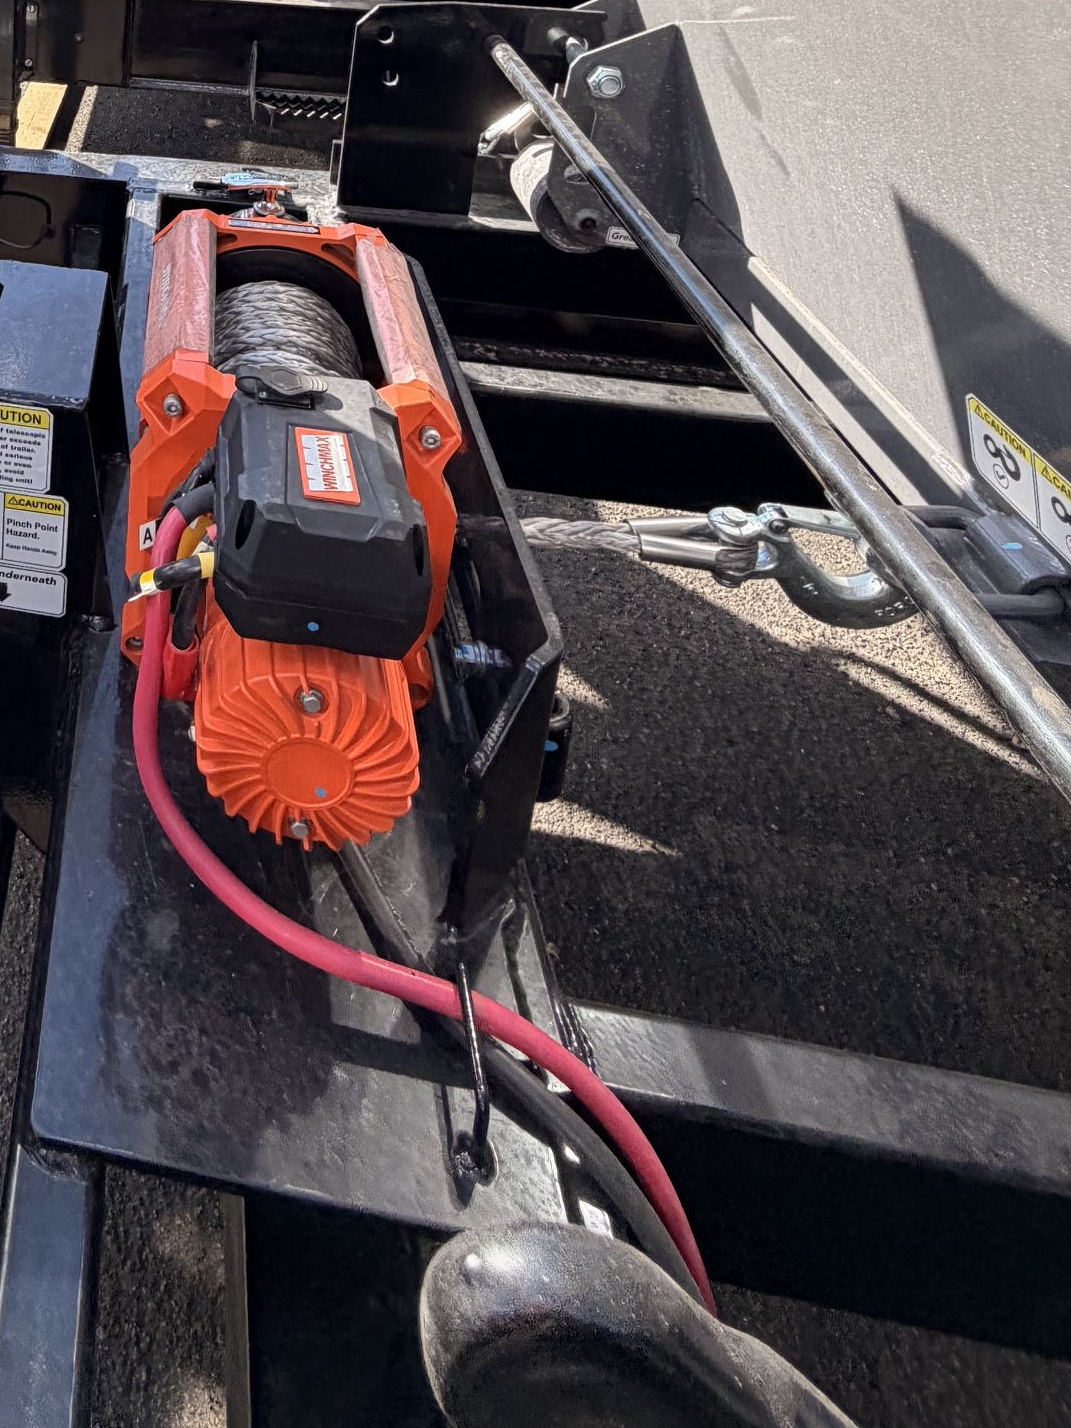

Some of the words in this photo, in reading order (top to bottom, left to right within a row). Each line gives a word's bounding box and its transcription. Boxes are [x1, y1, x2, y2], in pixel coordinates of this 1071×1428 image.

[611, 232, 633, 242] Gre
[5, 428, 46, 439] telescopic
[984, 412, 1027, 458] CAUTION
[9, 437, 41, 447] exceeds
[4, 452, 33, 461] serious
[13, 461, 32, 469] even
[315, 436, 338, 490] WINCHMAX
[4, 468, 25, 476] avoid
[18, 498, 62, 512] CAUTION
[6, 518, 32, 529] Pinch
[34, 522, 58, 533] Point
[6, 528, 41, 540] Hazard.
[143, 527, 153, 545] A
